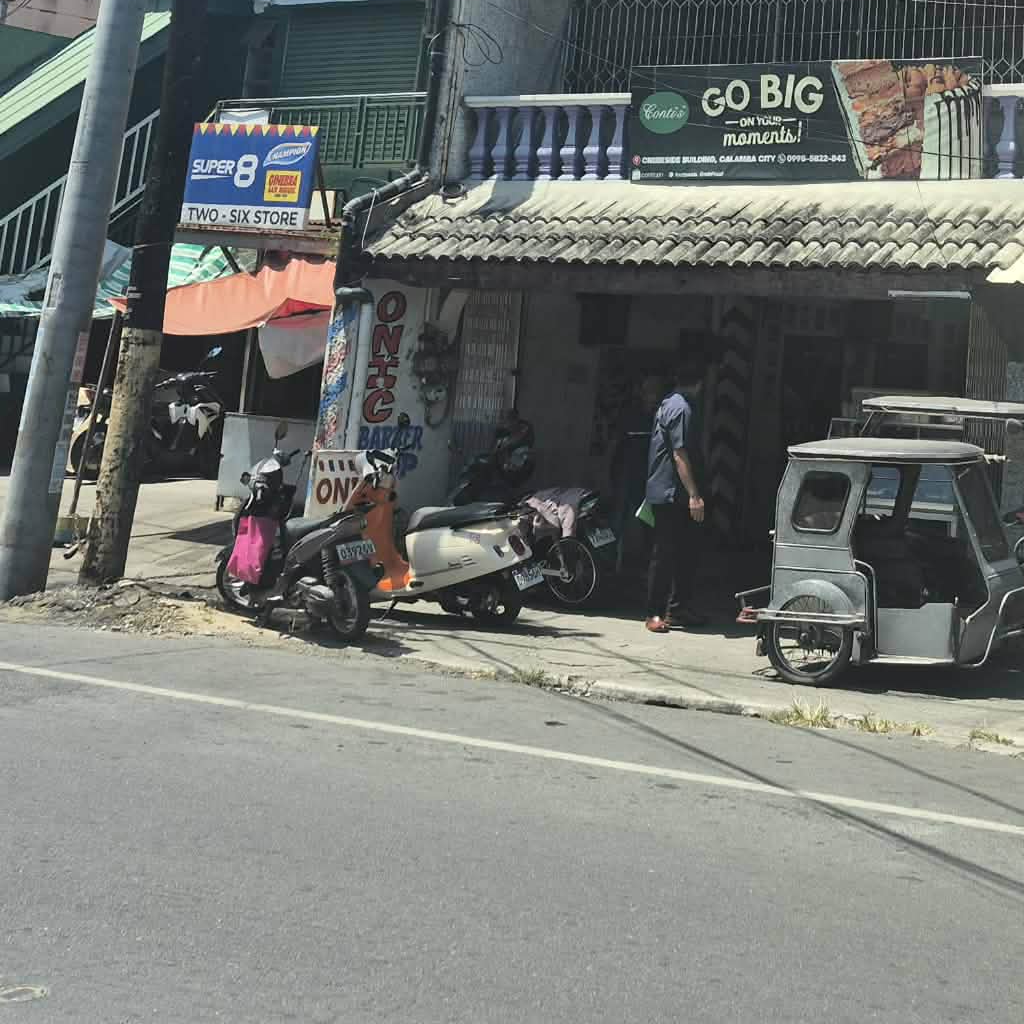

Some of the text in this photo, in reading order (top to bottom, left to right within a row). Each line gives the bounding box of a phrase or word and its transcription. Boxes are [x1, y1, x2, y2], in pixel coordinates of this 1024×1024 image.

[701, 74, 824, 117] GO BIG
[739, 115, 782, 128] ON YOUR
[723, 121, 803, 147] moments!
[758, 154, 776, 163] CITY
[192, 154, 259, 188] SUPER 8
[188, 207, 219, 223] TWO
[229, 209, 250, 224] SIX
[253, 210, 298, 226] STORE
